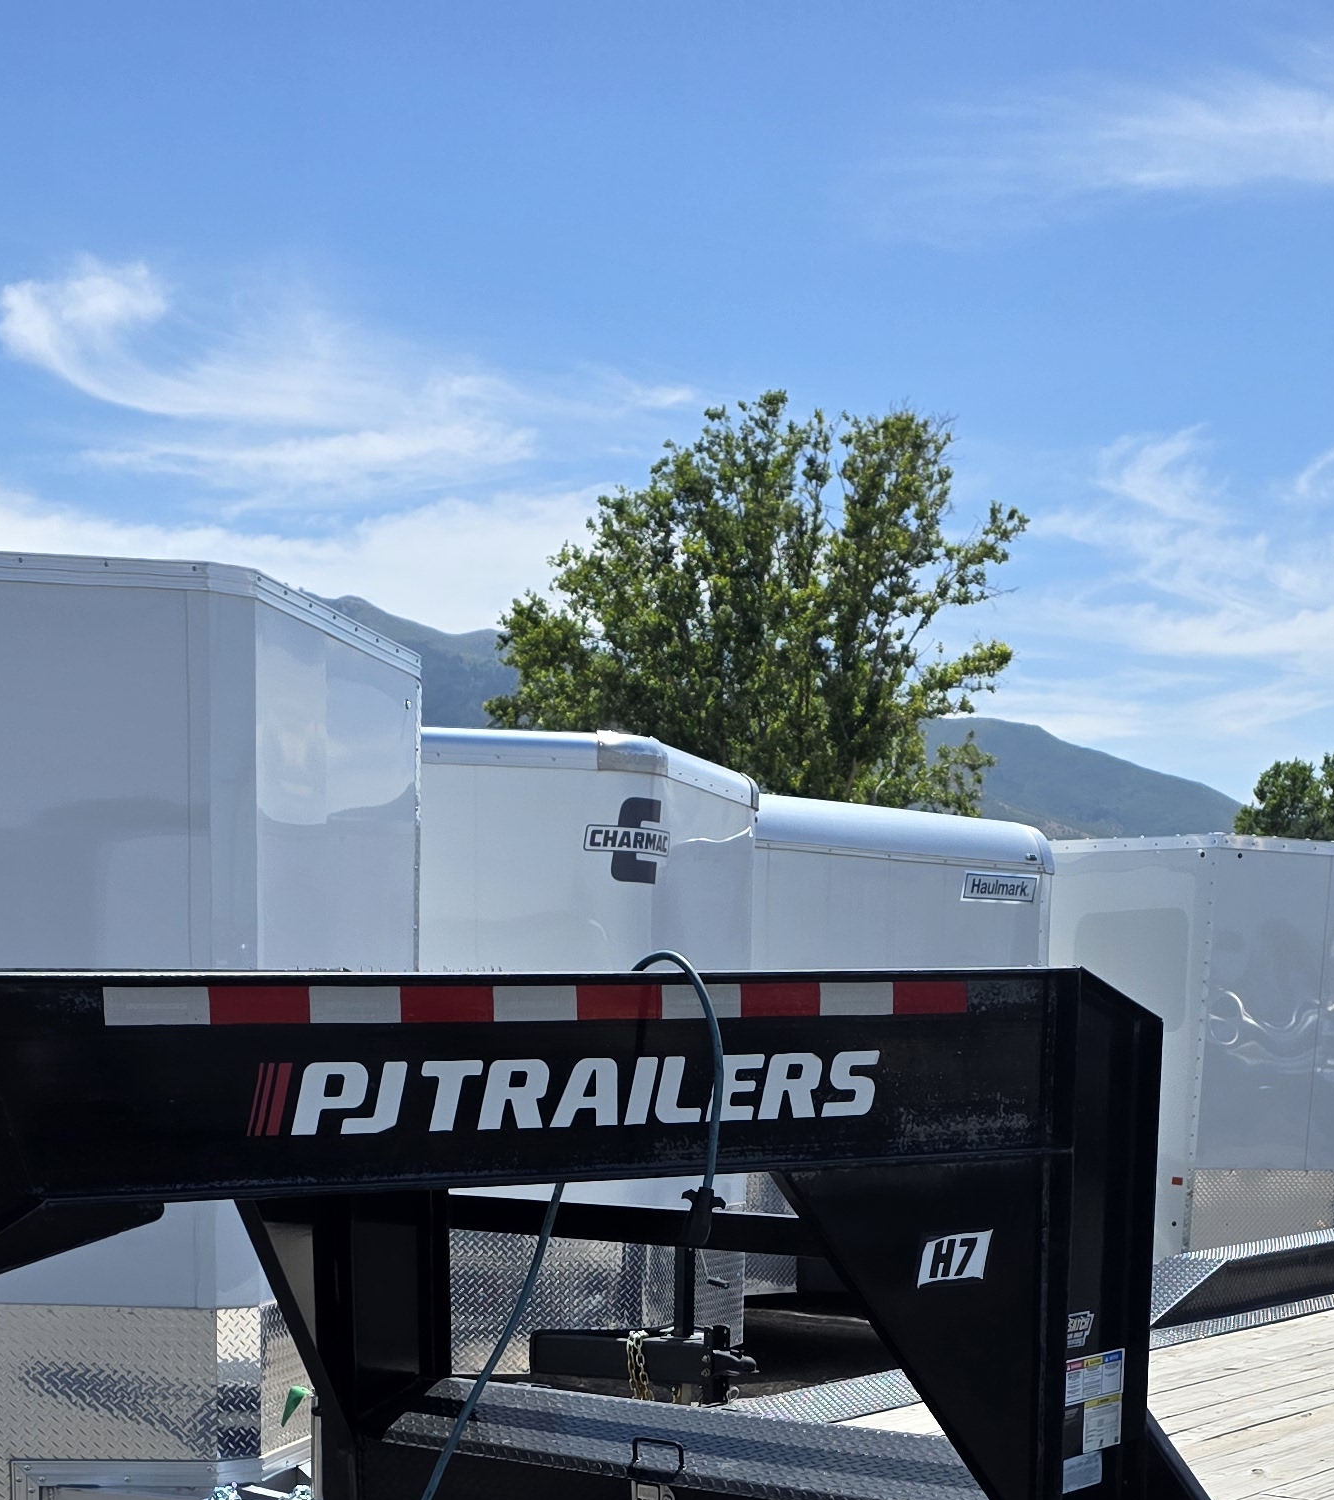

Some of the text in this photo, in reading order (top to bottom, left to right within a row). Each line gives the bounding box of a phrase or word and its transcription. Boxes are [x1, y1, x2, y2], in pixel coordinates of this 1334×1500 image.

[589, 829, 668, 853] CHARMAC
[970, 878, 1028, 896] Haulmark
[291, 1050, 880, 1136] PJ TRAILERS
[929, 1237, 978, 1279] H7
